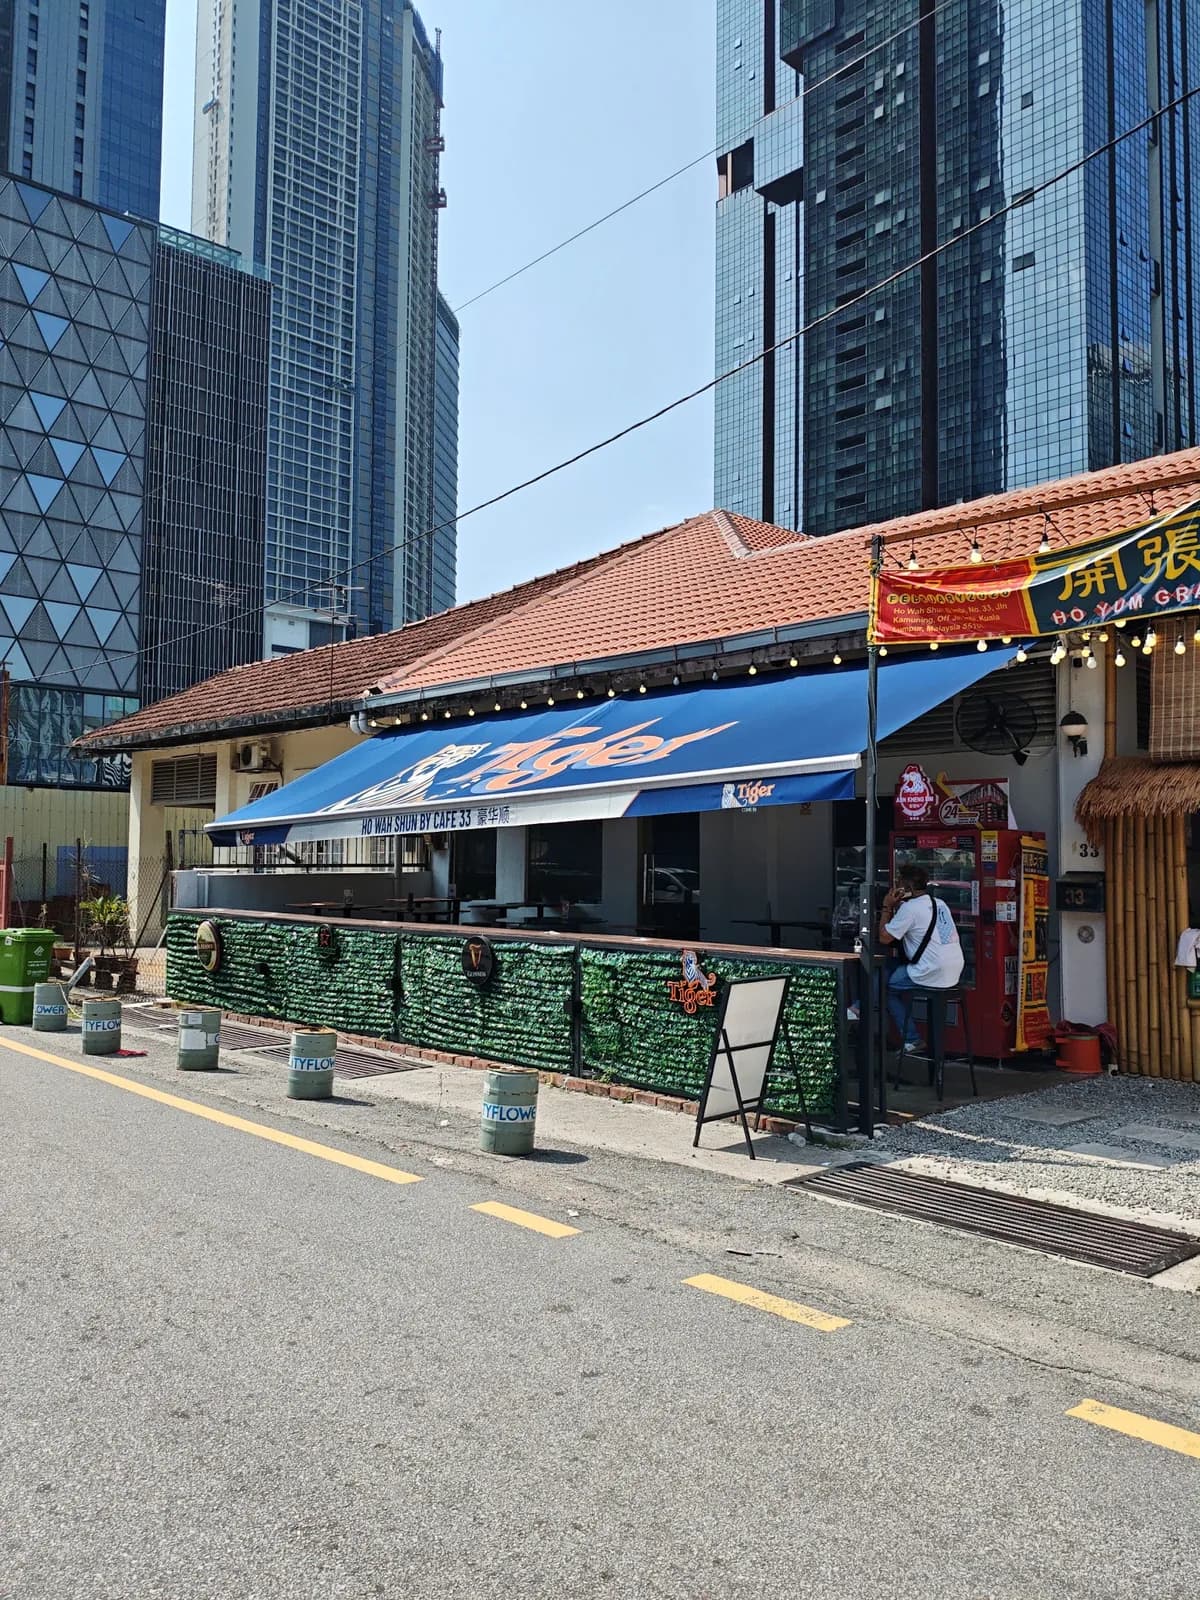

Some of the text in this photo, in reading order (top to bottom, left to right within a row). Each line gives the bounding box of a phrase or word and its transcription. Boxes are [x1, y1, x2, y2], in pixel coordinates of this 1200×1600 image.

[1052, 608, 1085, 625] HO
[456, 717, 740, 790] Tiger
[737, 780, 775, 804] Tiger
[361, 818, 372, 835] HO
[374, 815, 392, 834] WAH
[394, 815, 417, 833] SHUN
[419, 812, 432, 830] BY
[433, 810, 456, 828] CAFE
[459, 809, 471, 827] 33
[944, 805, 958, 818] 24
[1080, 844, 1099, 857] 33
[667, 980, 716, 1014] Tiger
